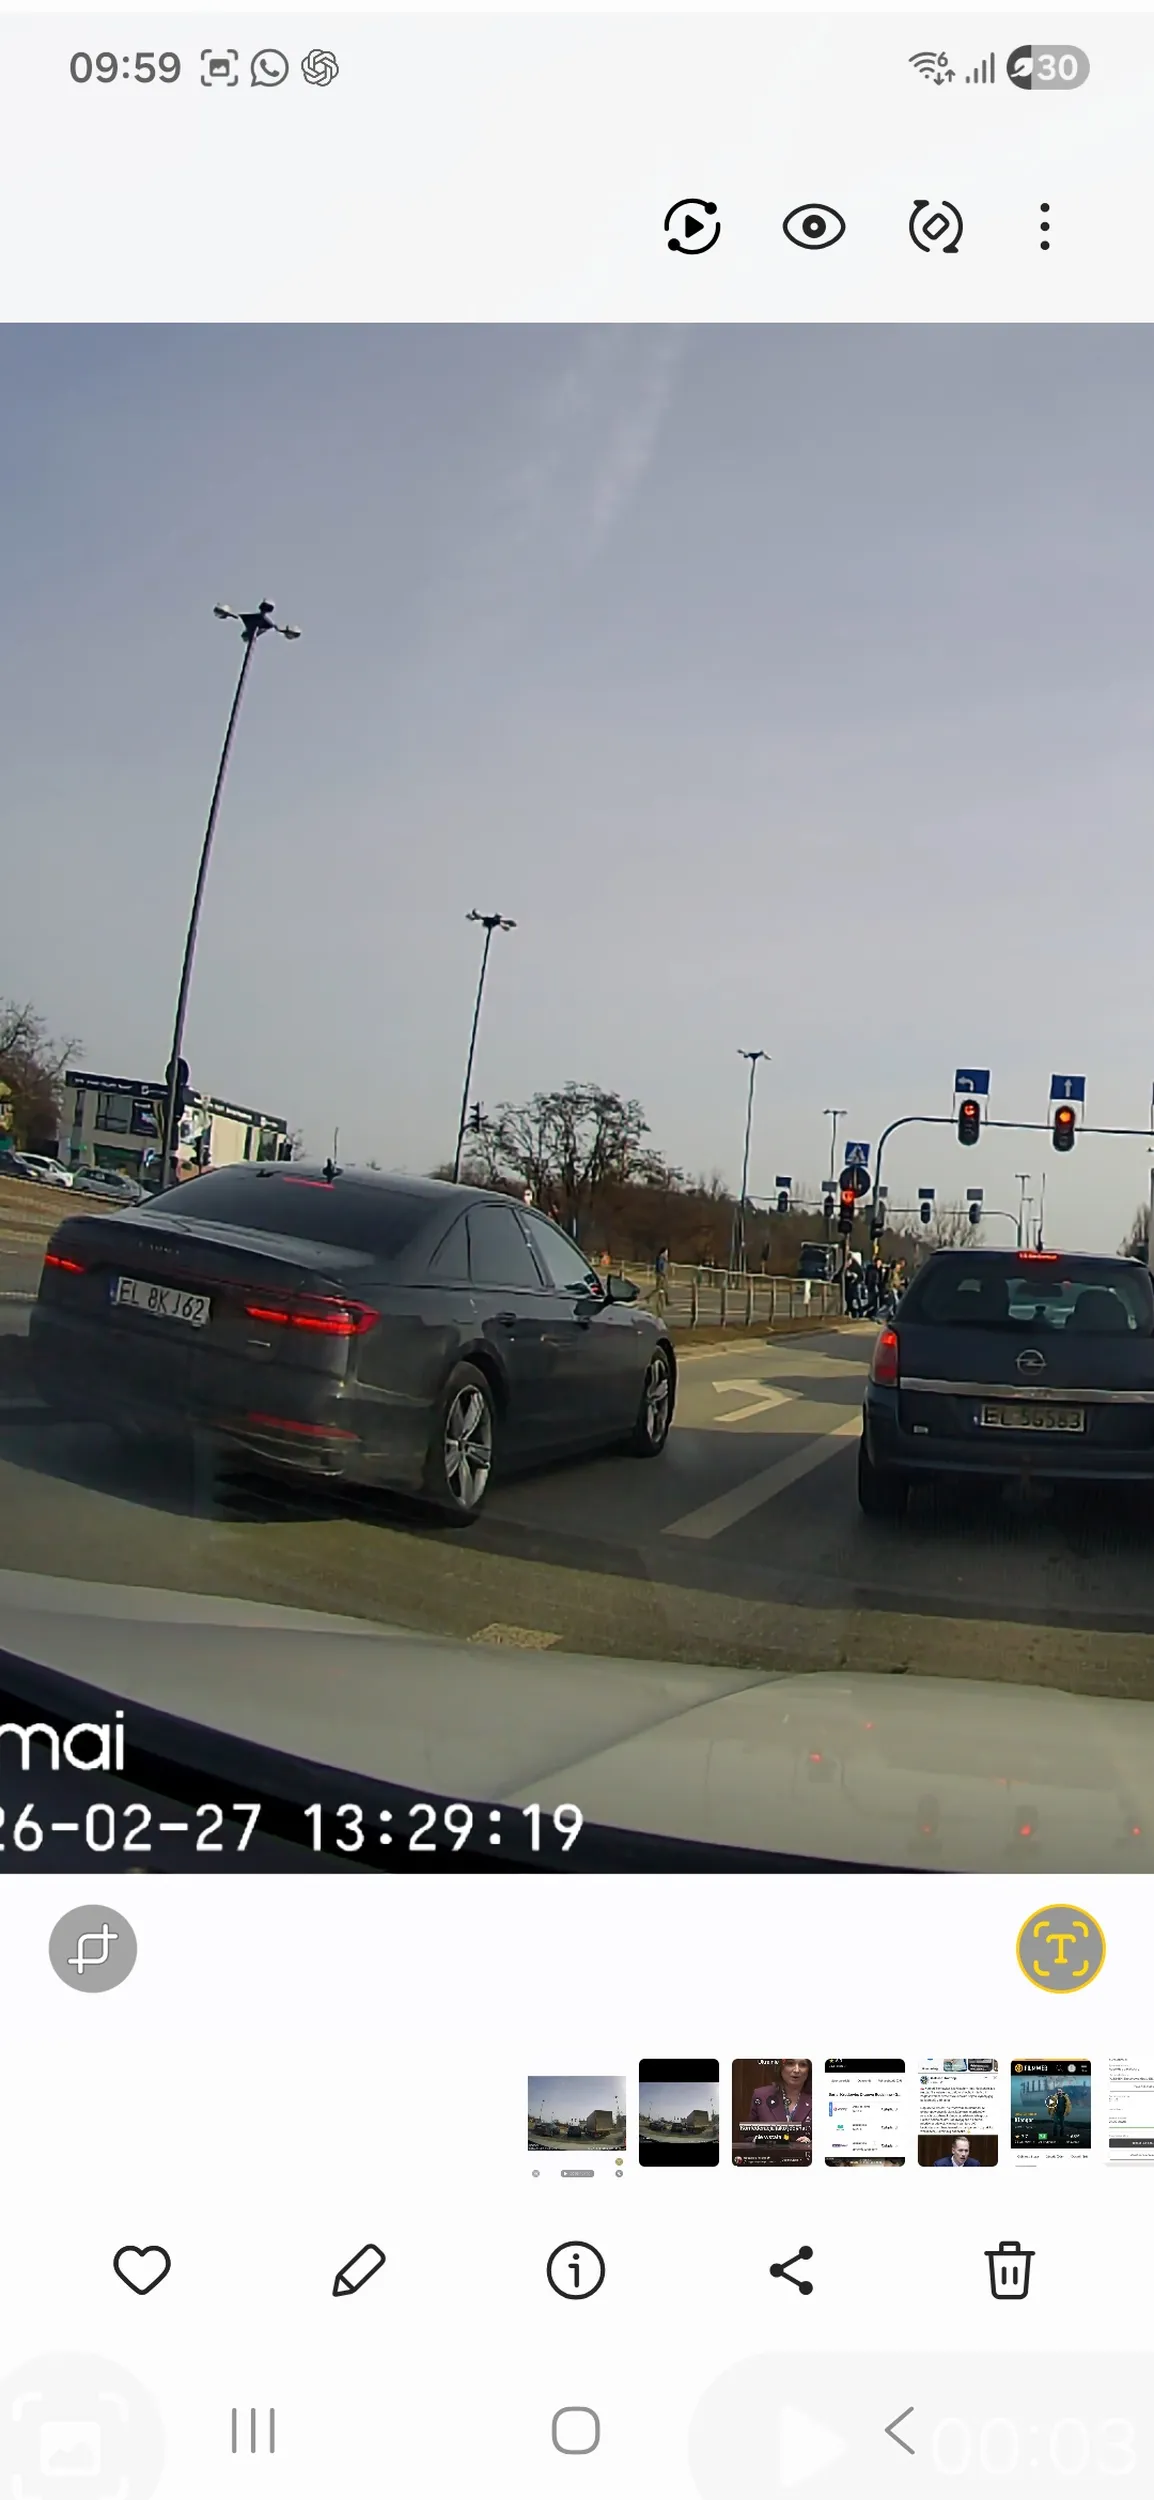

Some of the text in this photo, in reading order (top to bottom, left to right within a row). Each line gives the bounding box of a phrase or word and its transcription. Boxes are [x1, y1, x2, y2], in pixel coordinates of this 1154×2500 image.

[71, 52, 181, 83] 09:59
[1036, 54, 1078, 81] 30
[120, 1280, 139, 1305] EL
[984, 1407, 1012, 1426] EL
[931, 2417, 1138, 2475] 00:03
